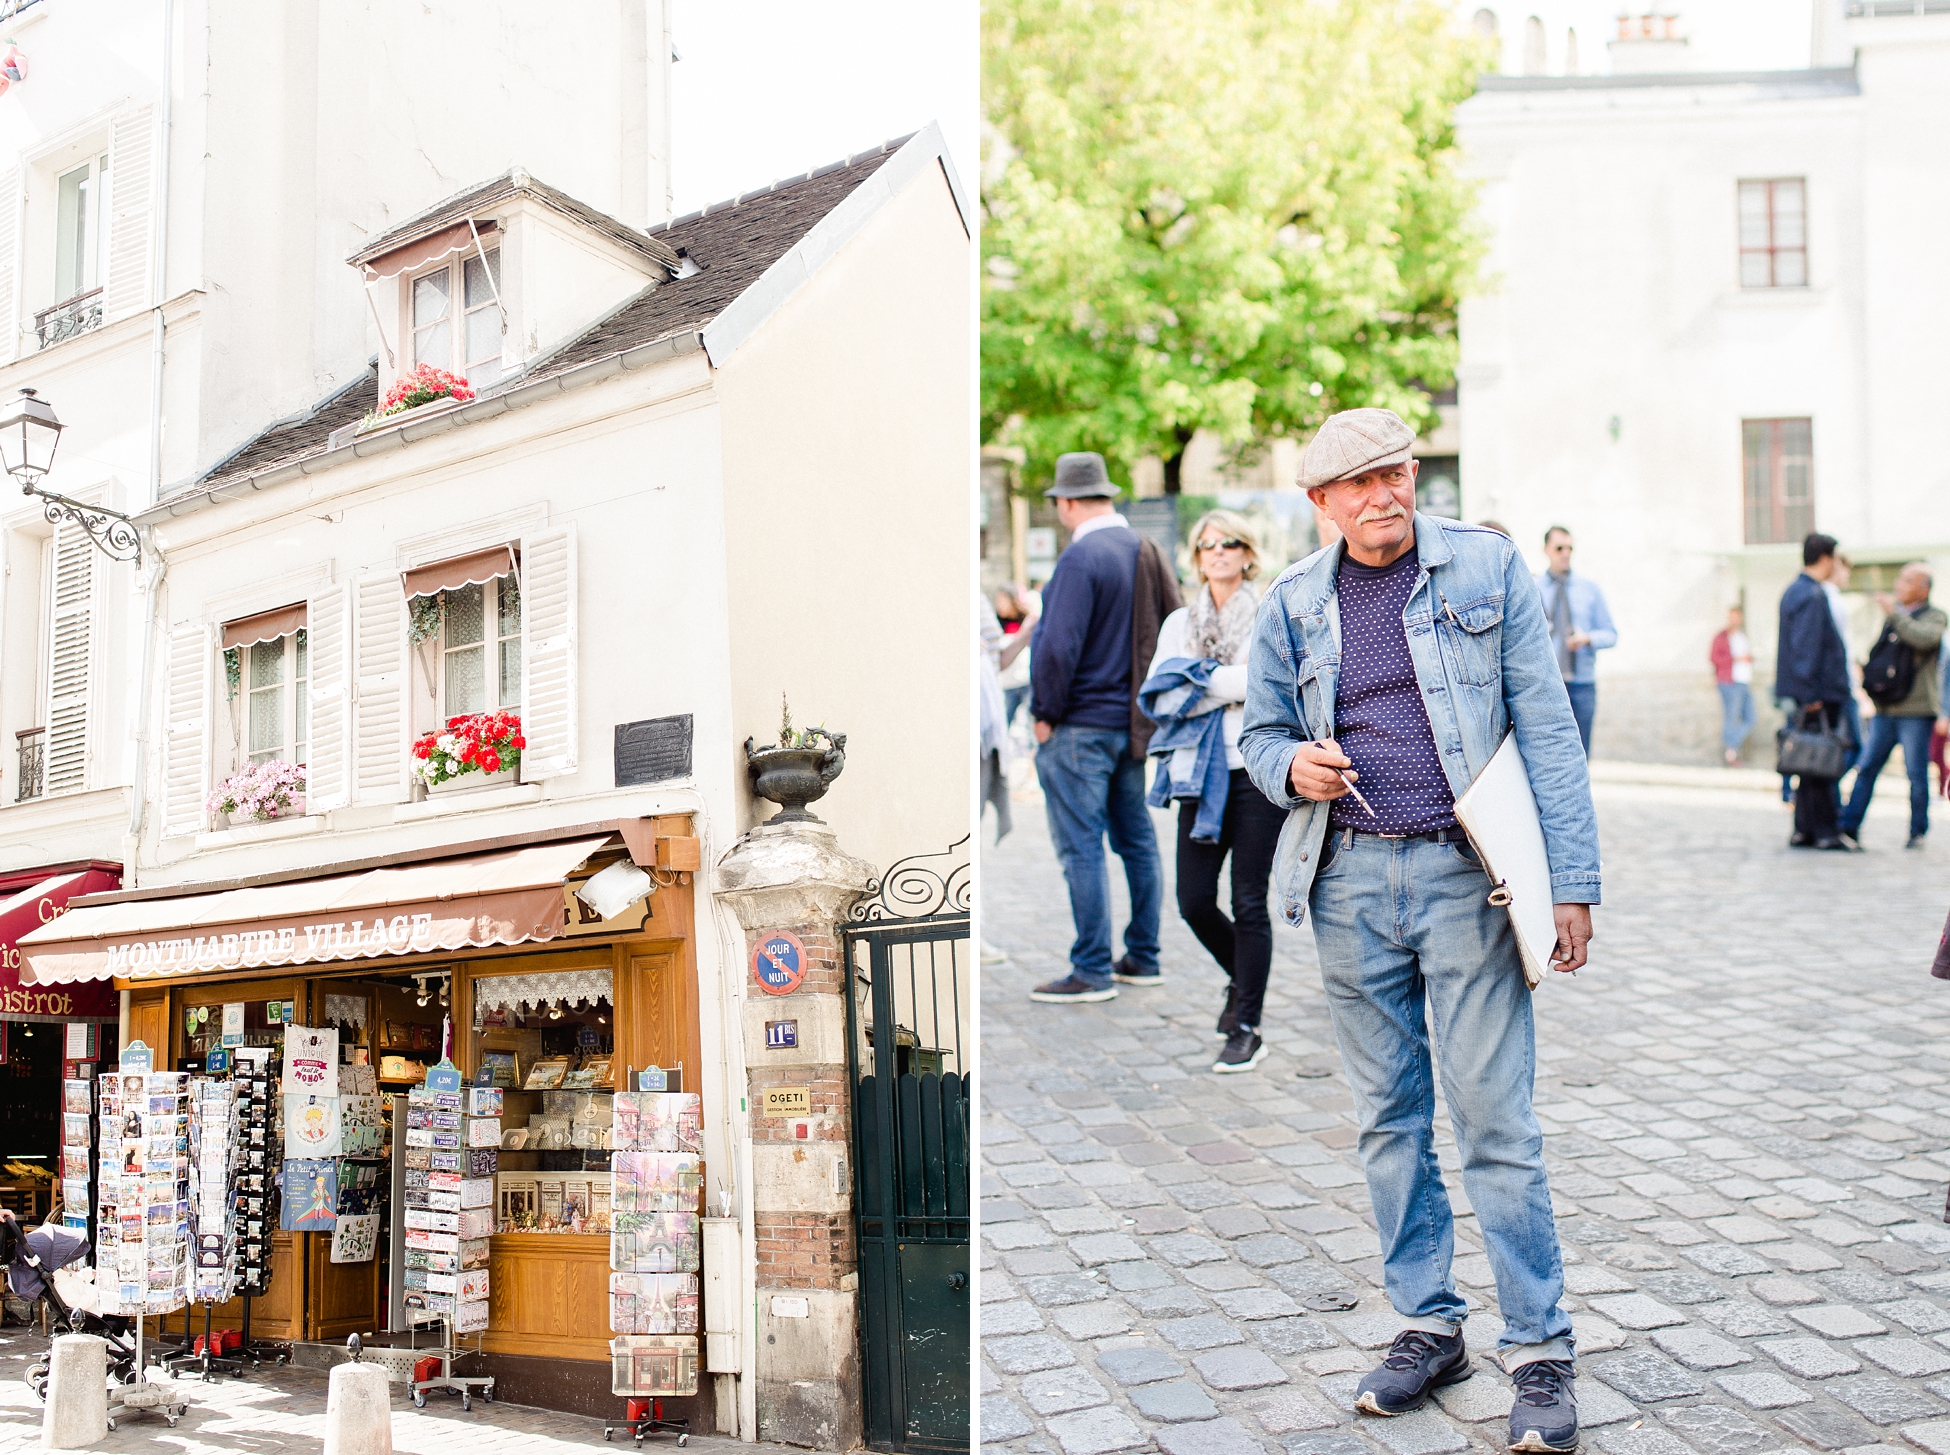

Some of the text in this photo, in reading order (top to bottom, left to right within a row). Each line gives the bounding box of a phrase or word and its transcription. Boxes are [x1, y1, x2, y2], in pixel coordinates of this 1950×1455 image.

[104, 912, 432, 970] MONTMARTRE VILLAGE
[765, 943, 790, 955] JOUR
[772, 958, 784, 969] ET
[768, 971, 789, 983] NUIT
[0, 985, 74, 1015] istrot
[768, 1024, 795, 1045] 11 BIS
[297, 1048, 325, 1060] UNIQUE
[295, 1070, 325, 1083] MONDE
[769, 1093, 803, 1103] OGETI
